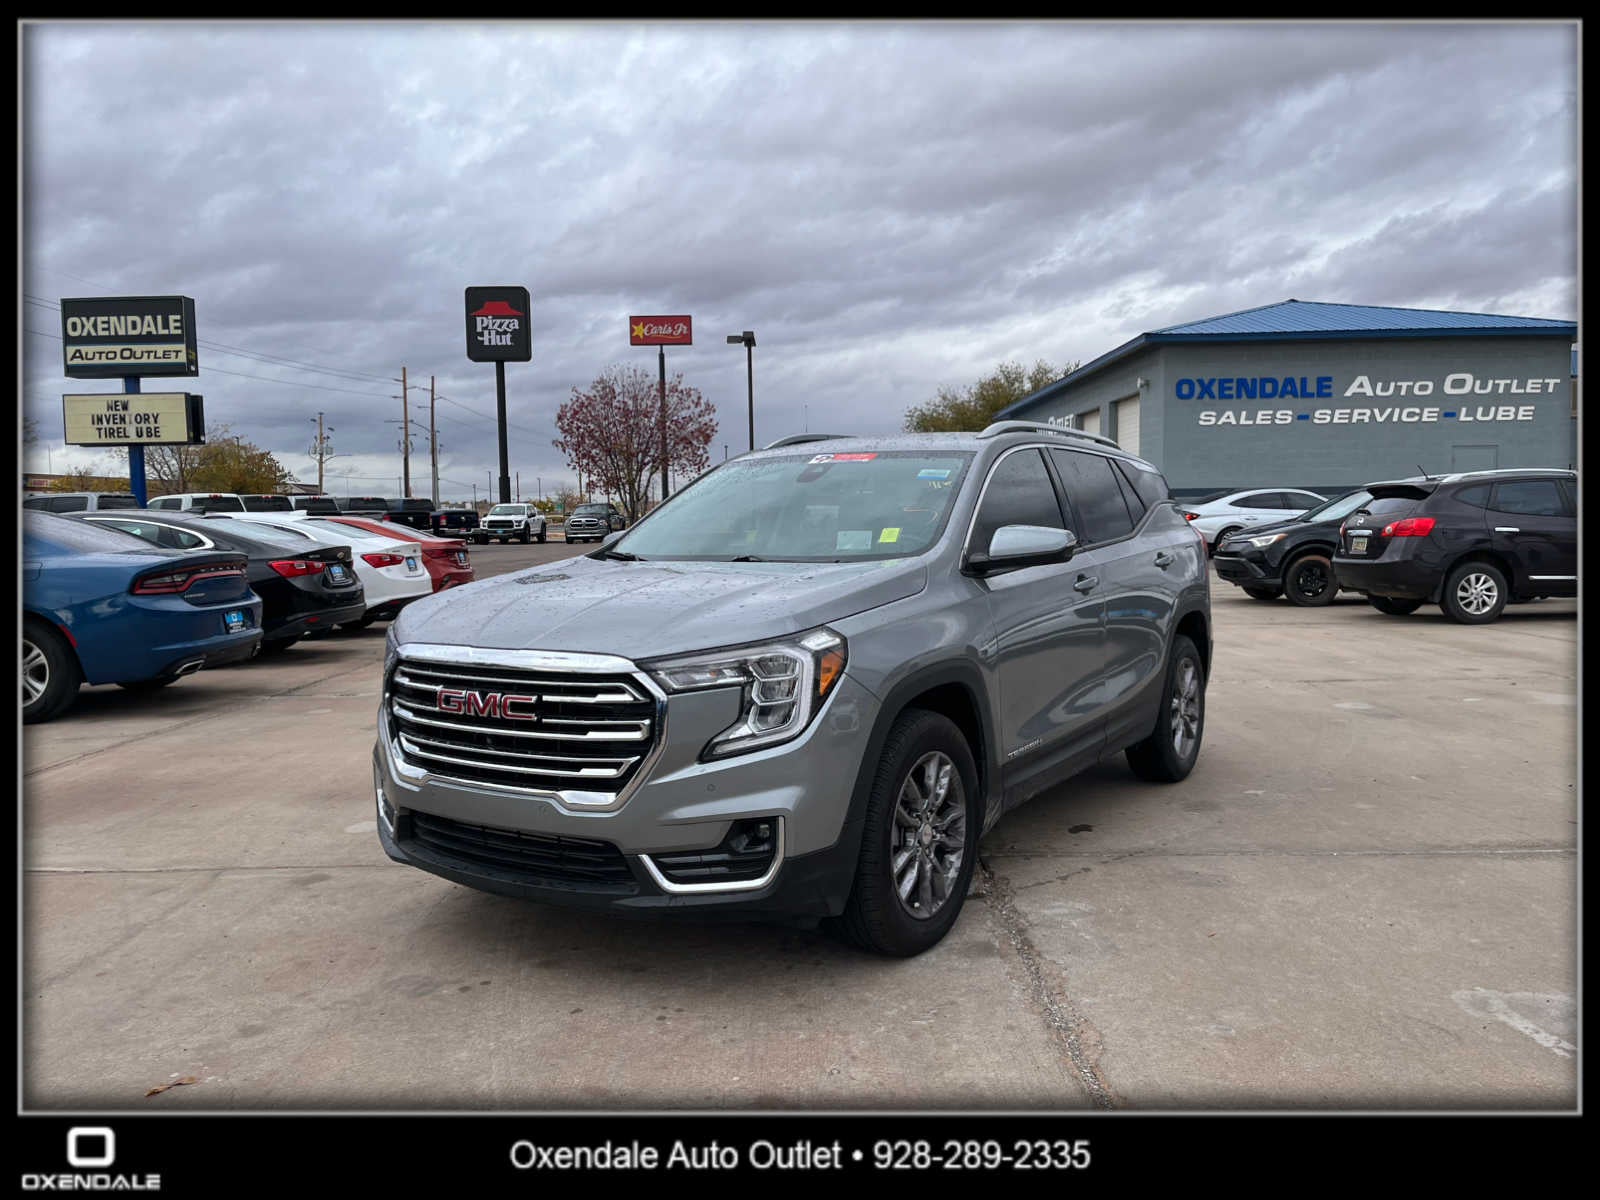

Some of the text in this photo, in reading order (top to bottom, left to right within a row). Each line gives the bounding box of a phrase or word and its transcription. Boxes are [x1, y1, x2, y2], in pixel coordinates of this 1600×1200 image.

[66, 314, 183, 337] OXENDALE
[475, 315, 520, 333] Pizza
[477, 329, 513, 346] Hut
[69, 347, 183, 362] AUTO OUTLET
[1175, 373, 1561, 400] OXENDALE AUTO OUTLET
[106, 399, 129, 412] NEW
[436, 688, 538, 721] GMC
